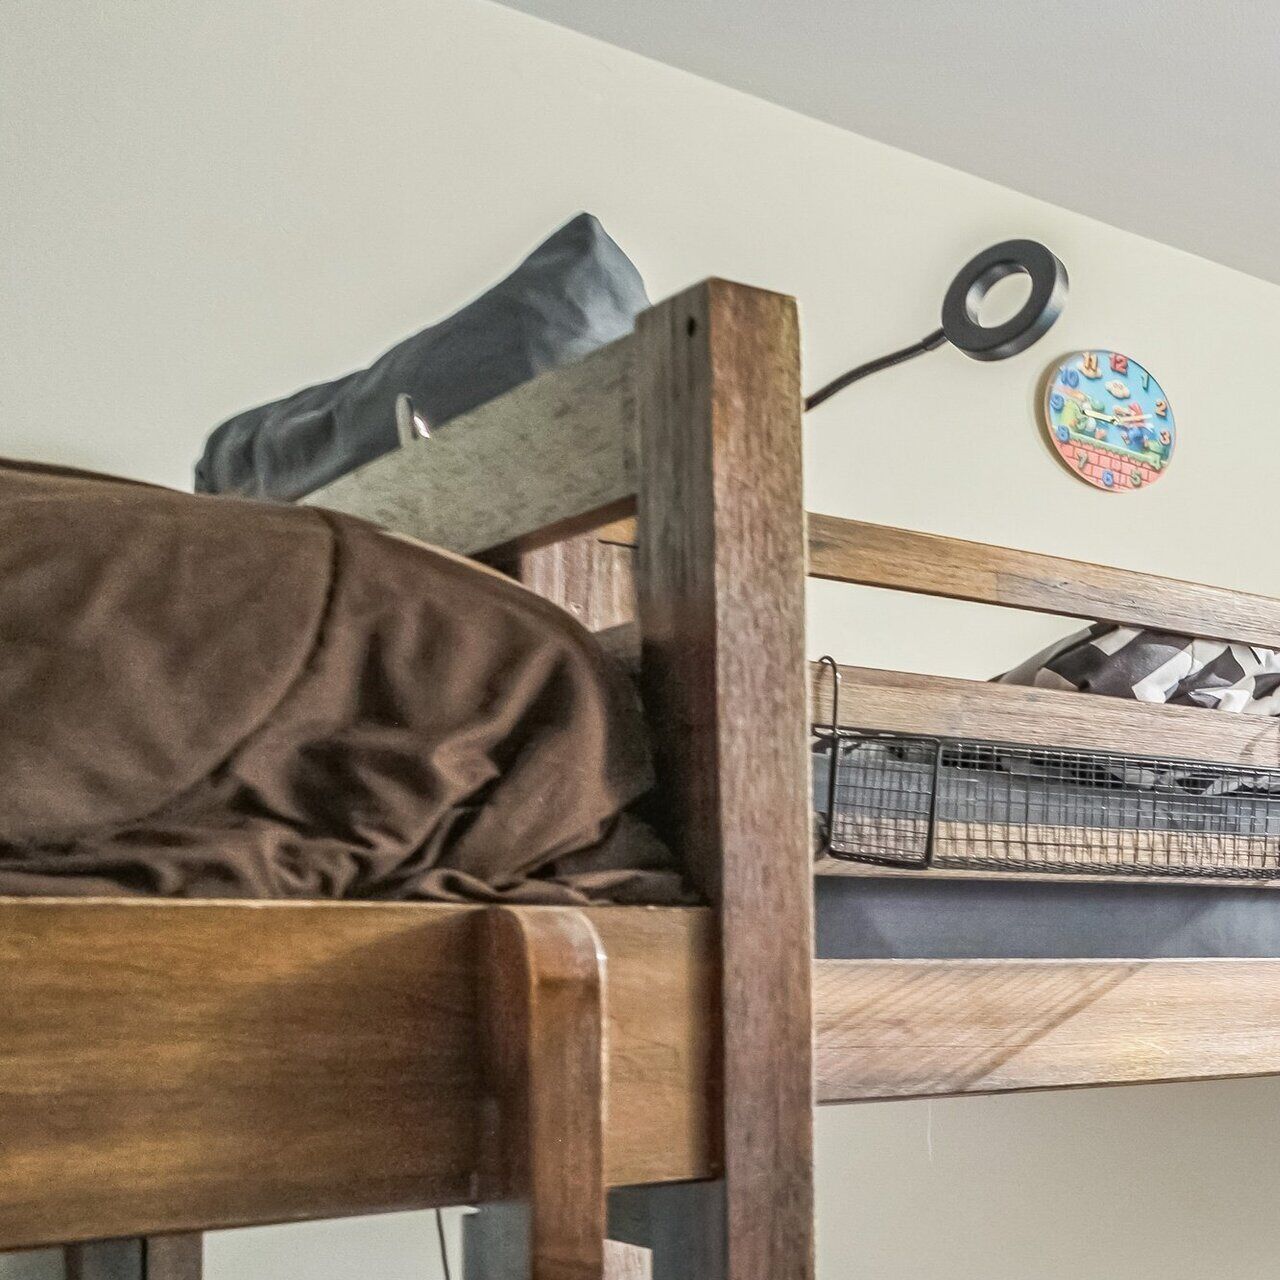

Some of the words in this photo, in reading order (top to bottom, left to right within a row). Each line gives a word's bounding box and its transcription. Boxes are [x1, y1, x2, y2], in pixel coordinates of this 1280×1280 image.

[1082, 352, 1098, 372] 11
[1109, 353, 1128, 376] 12
[1060, 367, 1079, 388] 10
[1141, 373, 1149, 391] 1
[1051, 394, 1064, 411] 9
[1155, 400, 1167, 416] 2
[1160, 430, 1171, 445] 3
[1077, 449, 1088, 469] 7
[1102, 469, 1114, 487] 6
[1130, 470, 1142, 487] 5
